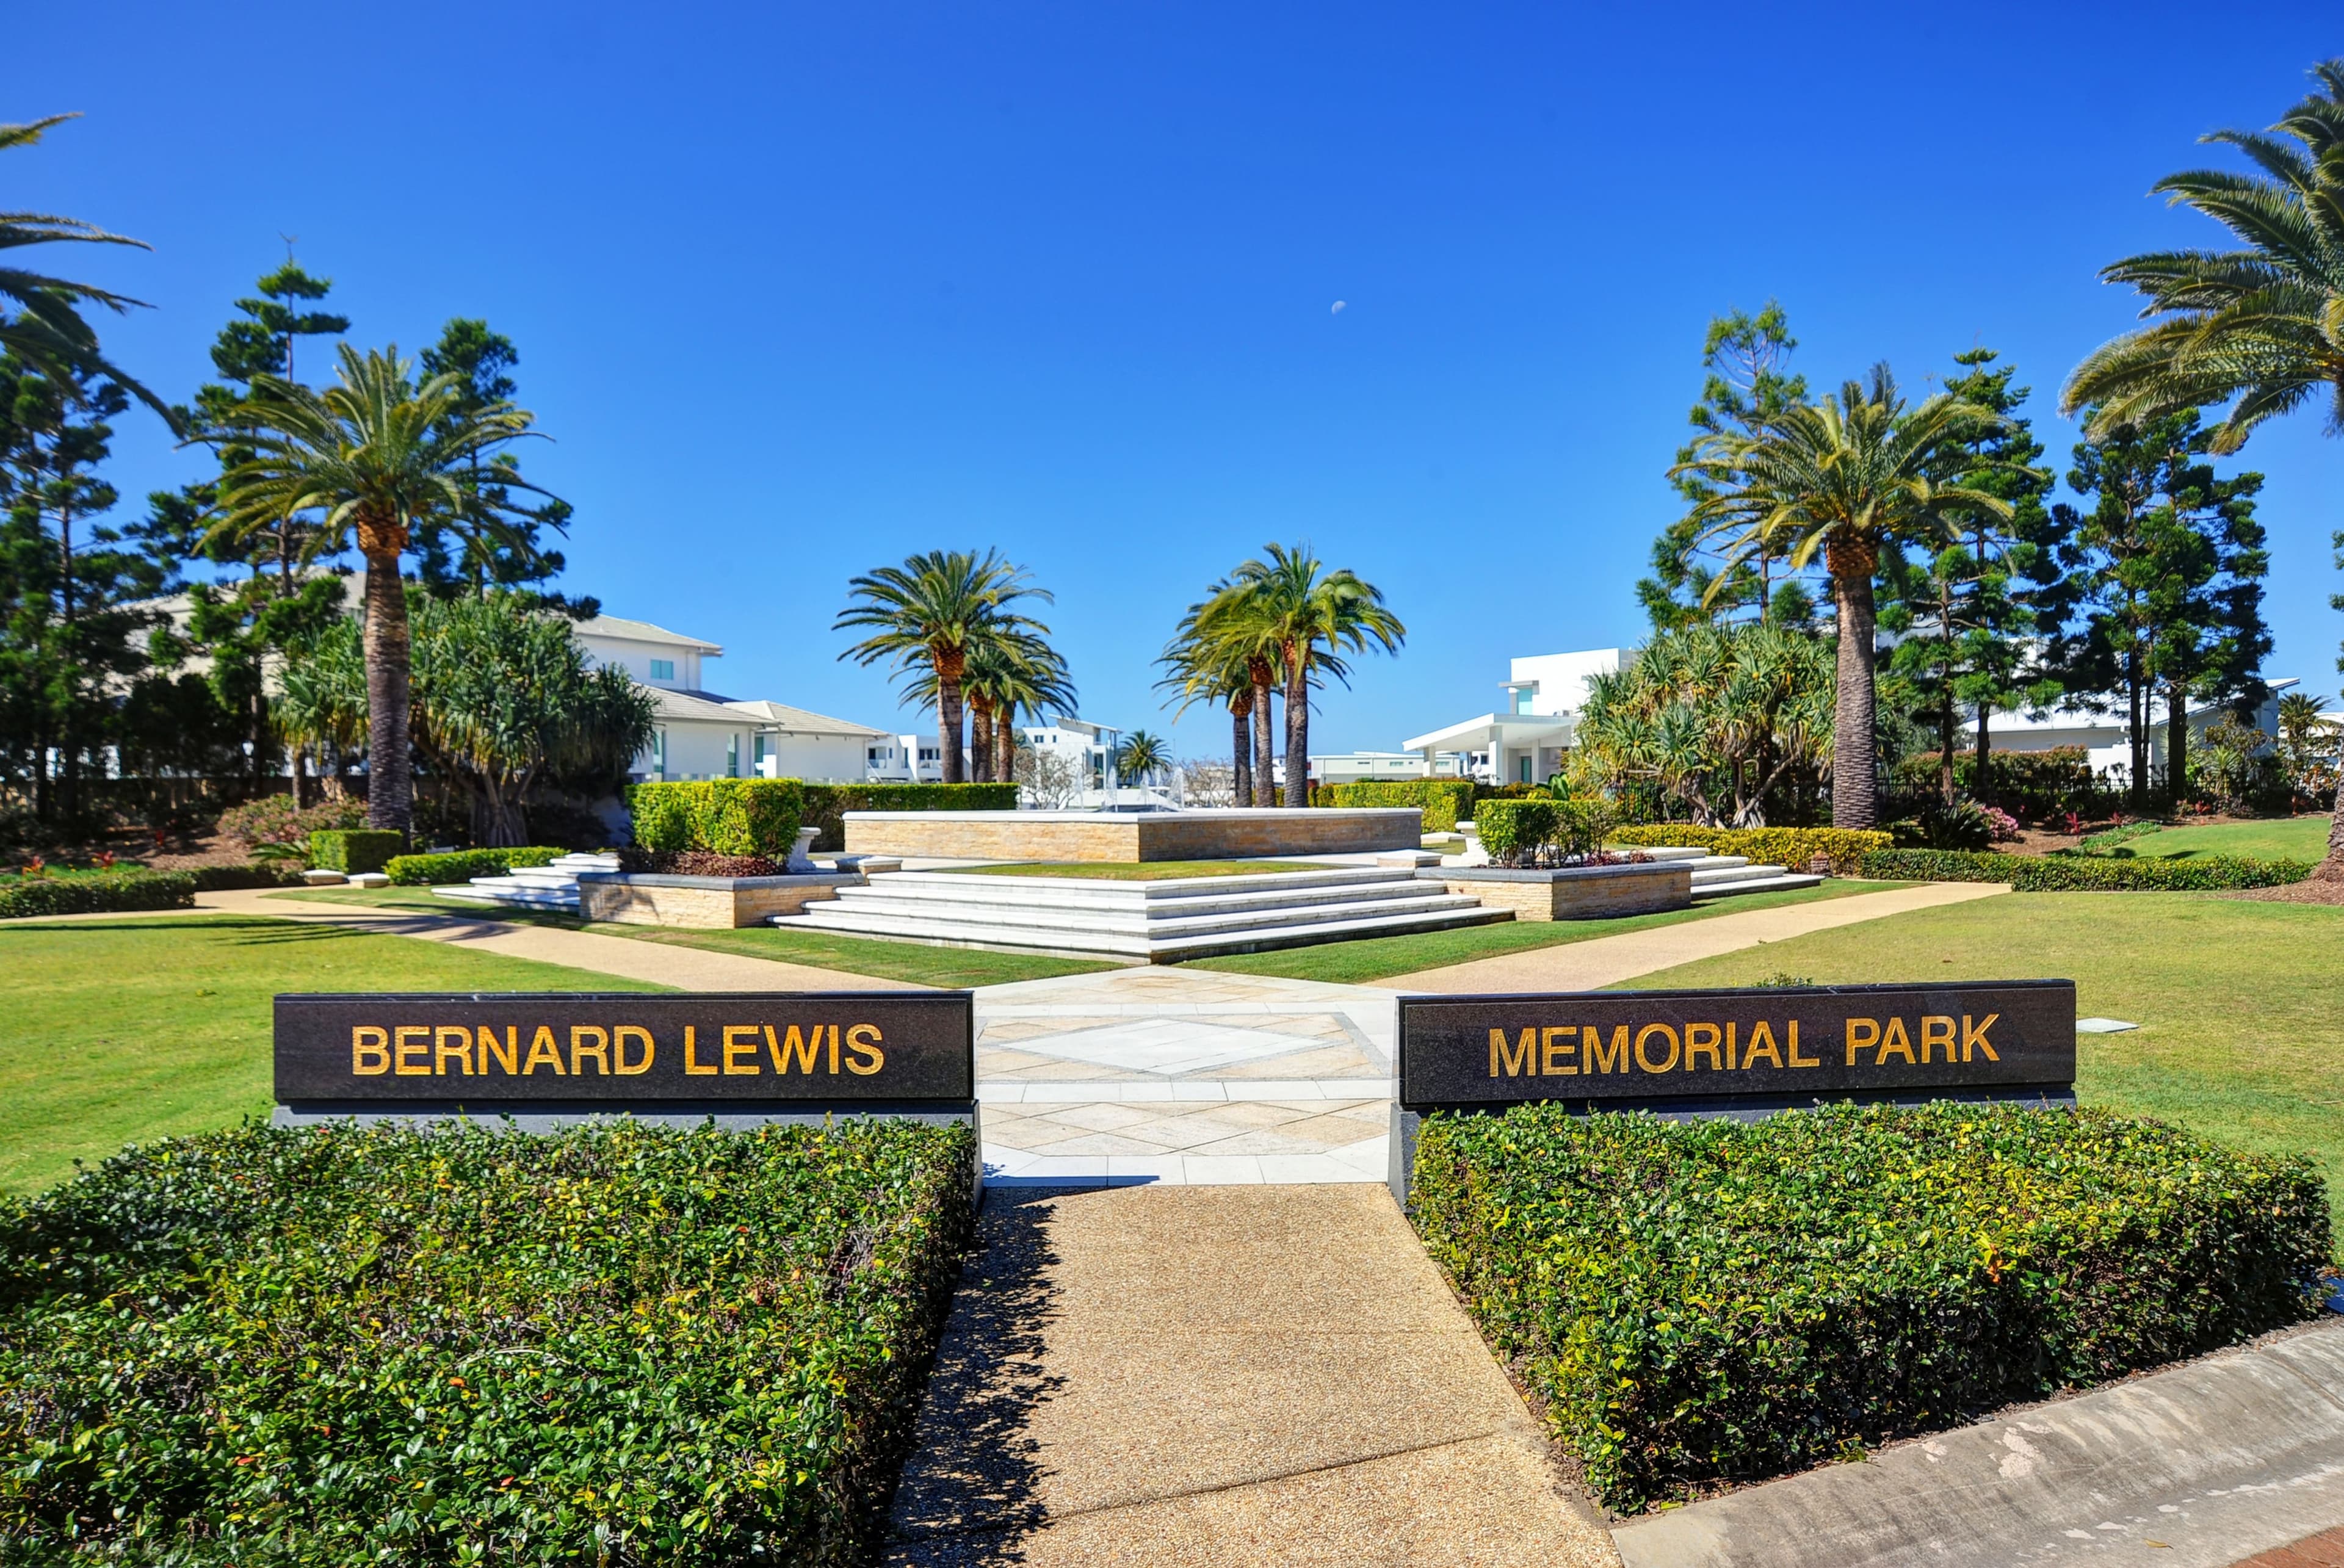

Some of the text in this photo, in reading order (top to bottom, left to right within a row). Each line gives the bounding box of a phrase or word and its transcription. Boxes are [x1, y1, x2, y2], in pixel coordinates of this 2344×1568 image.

[351, 1023, 885, 1076] BERNARD LEWIS
[1488, 1013, 2001, 1077] MEMORIAL PARK
